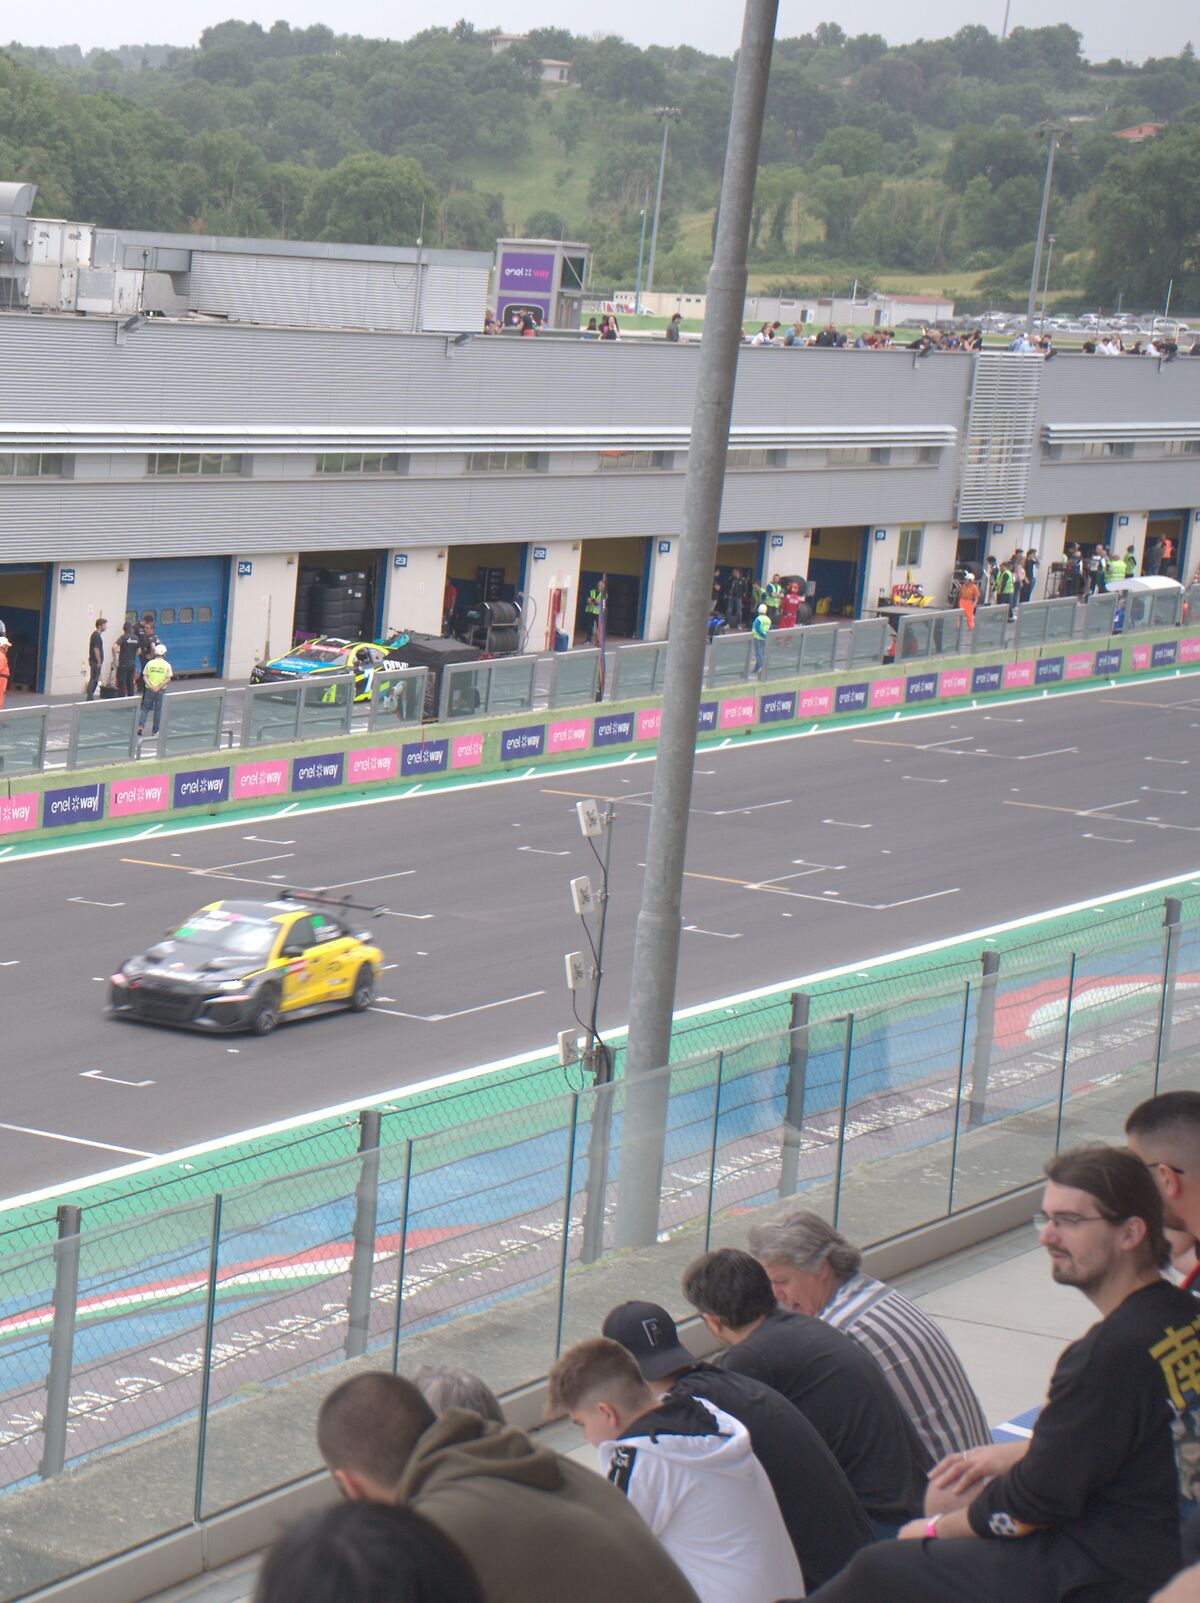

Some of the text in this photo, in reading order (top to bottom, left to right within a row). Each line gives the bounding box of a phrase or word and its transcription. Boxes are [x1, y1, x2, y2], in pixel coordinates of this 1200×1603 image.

[505, 268, 549, 280] enel way
[395, 556, 406, 565] 23
[535, 549, 545, 558] 22
[239, 563, 251, 573] 24
[61, 572, 74, 581] 25
[641, 716, 655, 728] enel
[703, 711, 714, 723] way
[552, 728, 586, 743] enel way
[598, 722, 630, 736] enel way
[506, 735, 540, 750] enel way
[406, 748, 443, 765] enel way
[457, 744, 473, 757] enel
[298, 762, 339, 780] enel way
[353, 755, 392, 772] enel way
[240, 768, 282, 787] enel way
[181, 777, 224, 795] enel way
[117, 784, 162, 804] enel way
[51, 793, 98, 814] enel way
[12, 805, 31, 823] way
